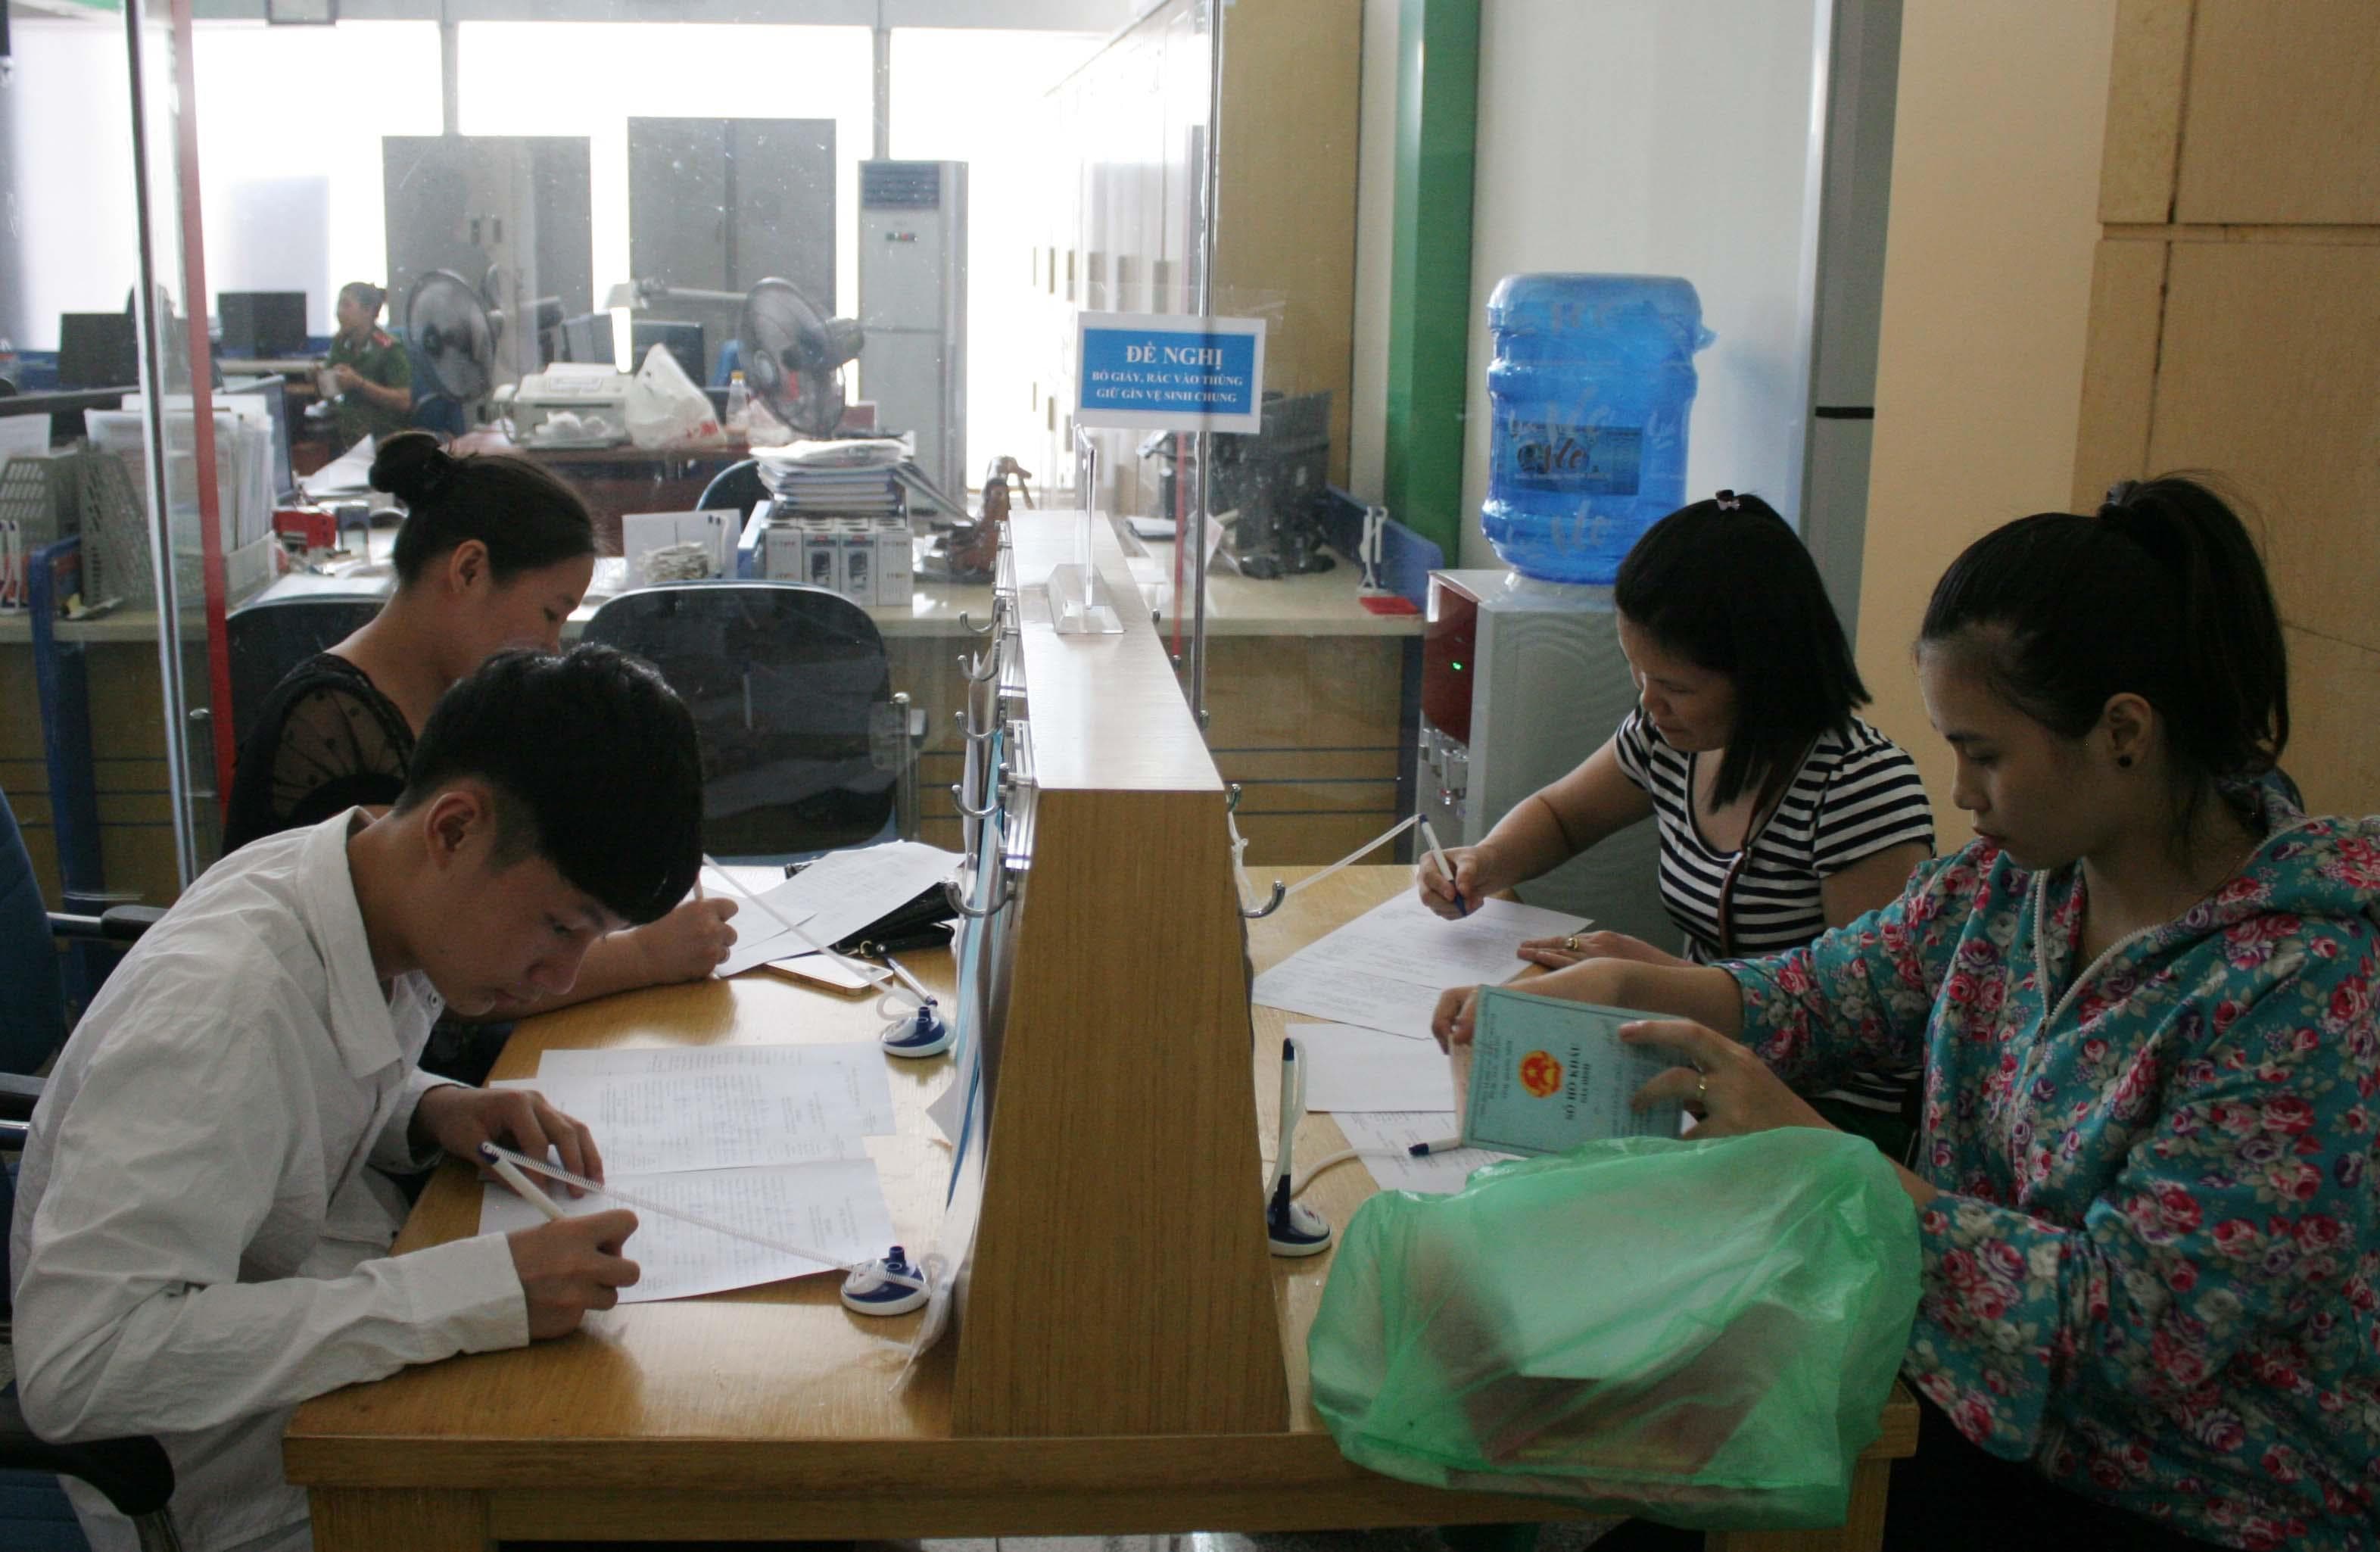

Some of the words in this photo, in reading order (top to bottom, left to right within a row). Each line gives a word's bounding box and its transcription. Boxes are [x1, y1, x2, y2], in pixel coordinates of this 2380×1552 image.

[1164, 346, 1223, 370] NGHỊ
[1147, 371, 1171, 383] RÁC
[1174, 372, 1199, 385] VÀO
[1202, 373, 1243, 386] THÙNG
[1164, 391, 1192, 400] SINH
[1195, 391, 1237, 403] CHUNG
